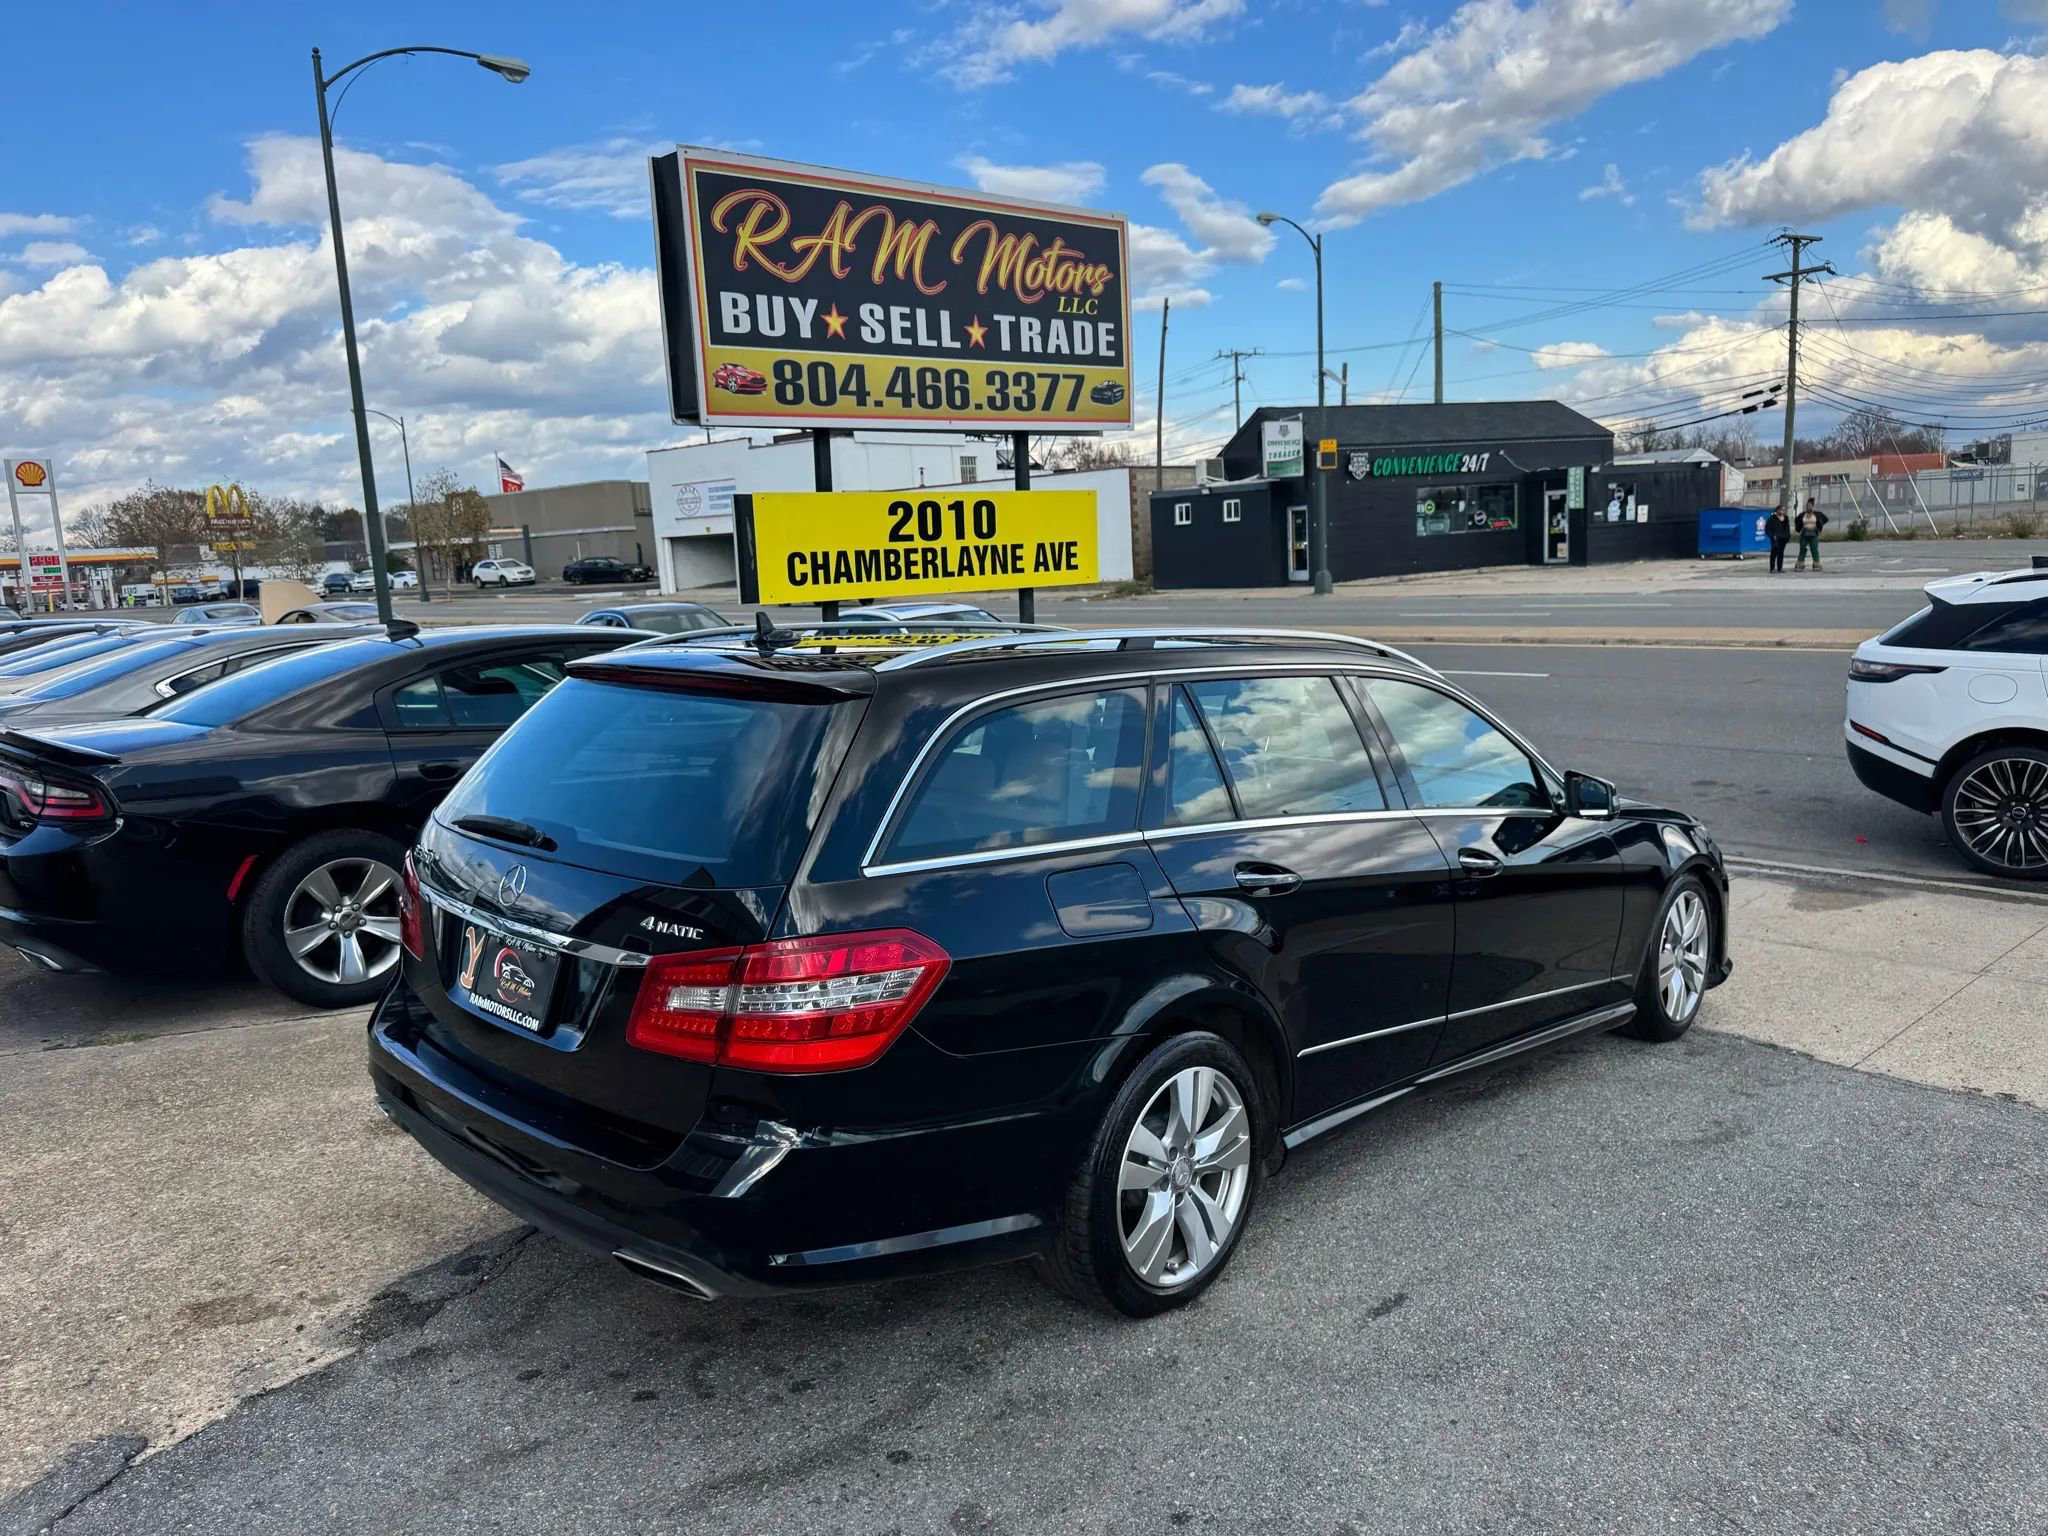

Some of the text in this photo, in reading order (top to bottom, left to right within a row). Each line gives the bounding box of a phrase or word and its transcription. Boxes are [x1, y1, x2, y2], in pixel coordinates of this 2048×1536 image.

[951, 220, 1113, 304] Motors
[719, 291, 1116, 357] BUY SELL TRADE
[1057, 296, 1098, 315] LLC
[773, 359, 1085, 412] 804.466.3377
[1373, 453, 1461, 476] CONVENIENCE
[1460, 453, 1490, 472] 24/7
[888, 500, 996, 542] 2010
[787, 541, 1079, 586] CHAMBERLAYNE AVE
